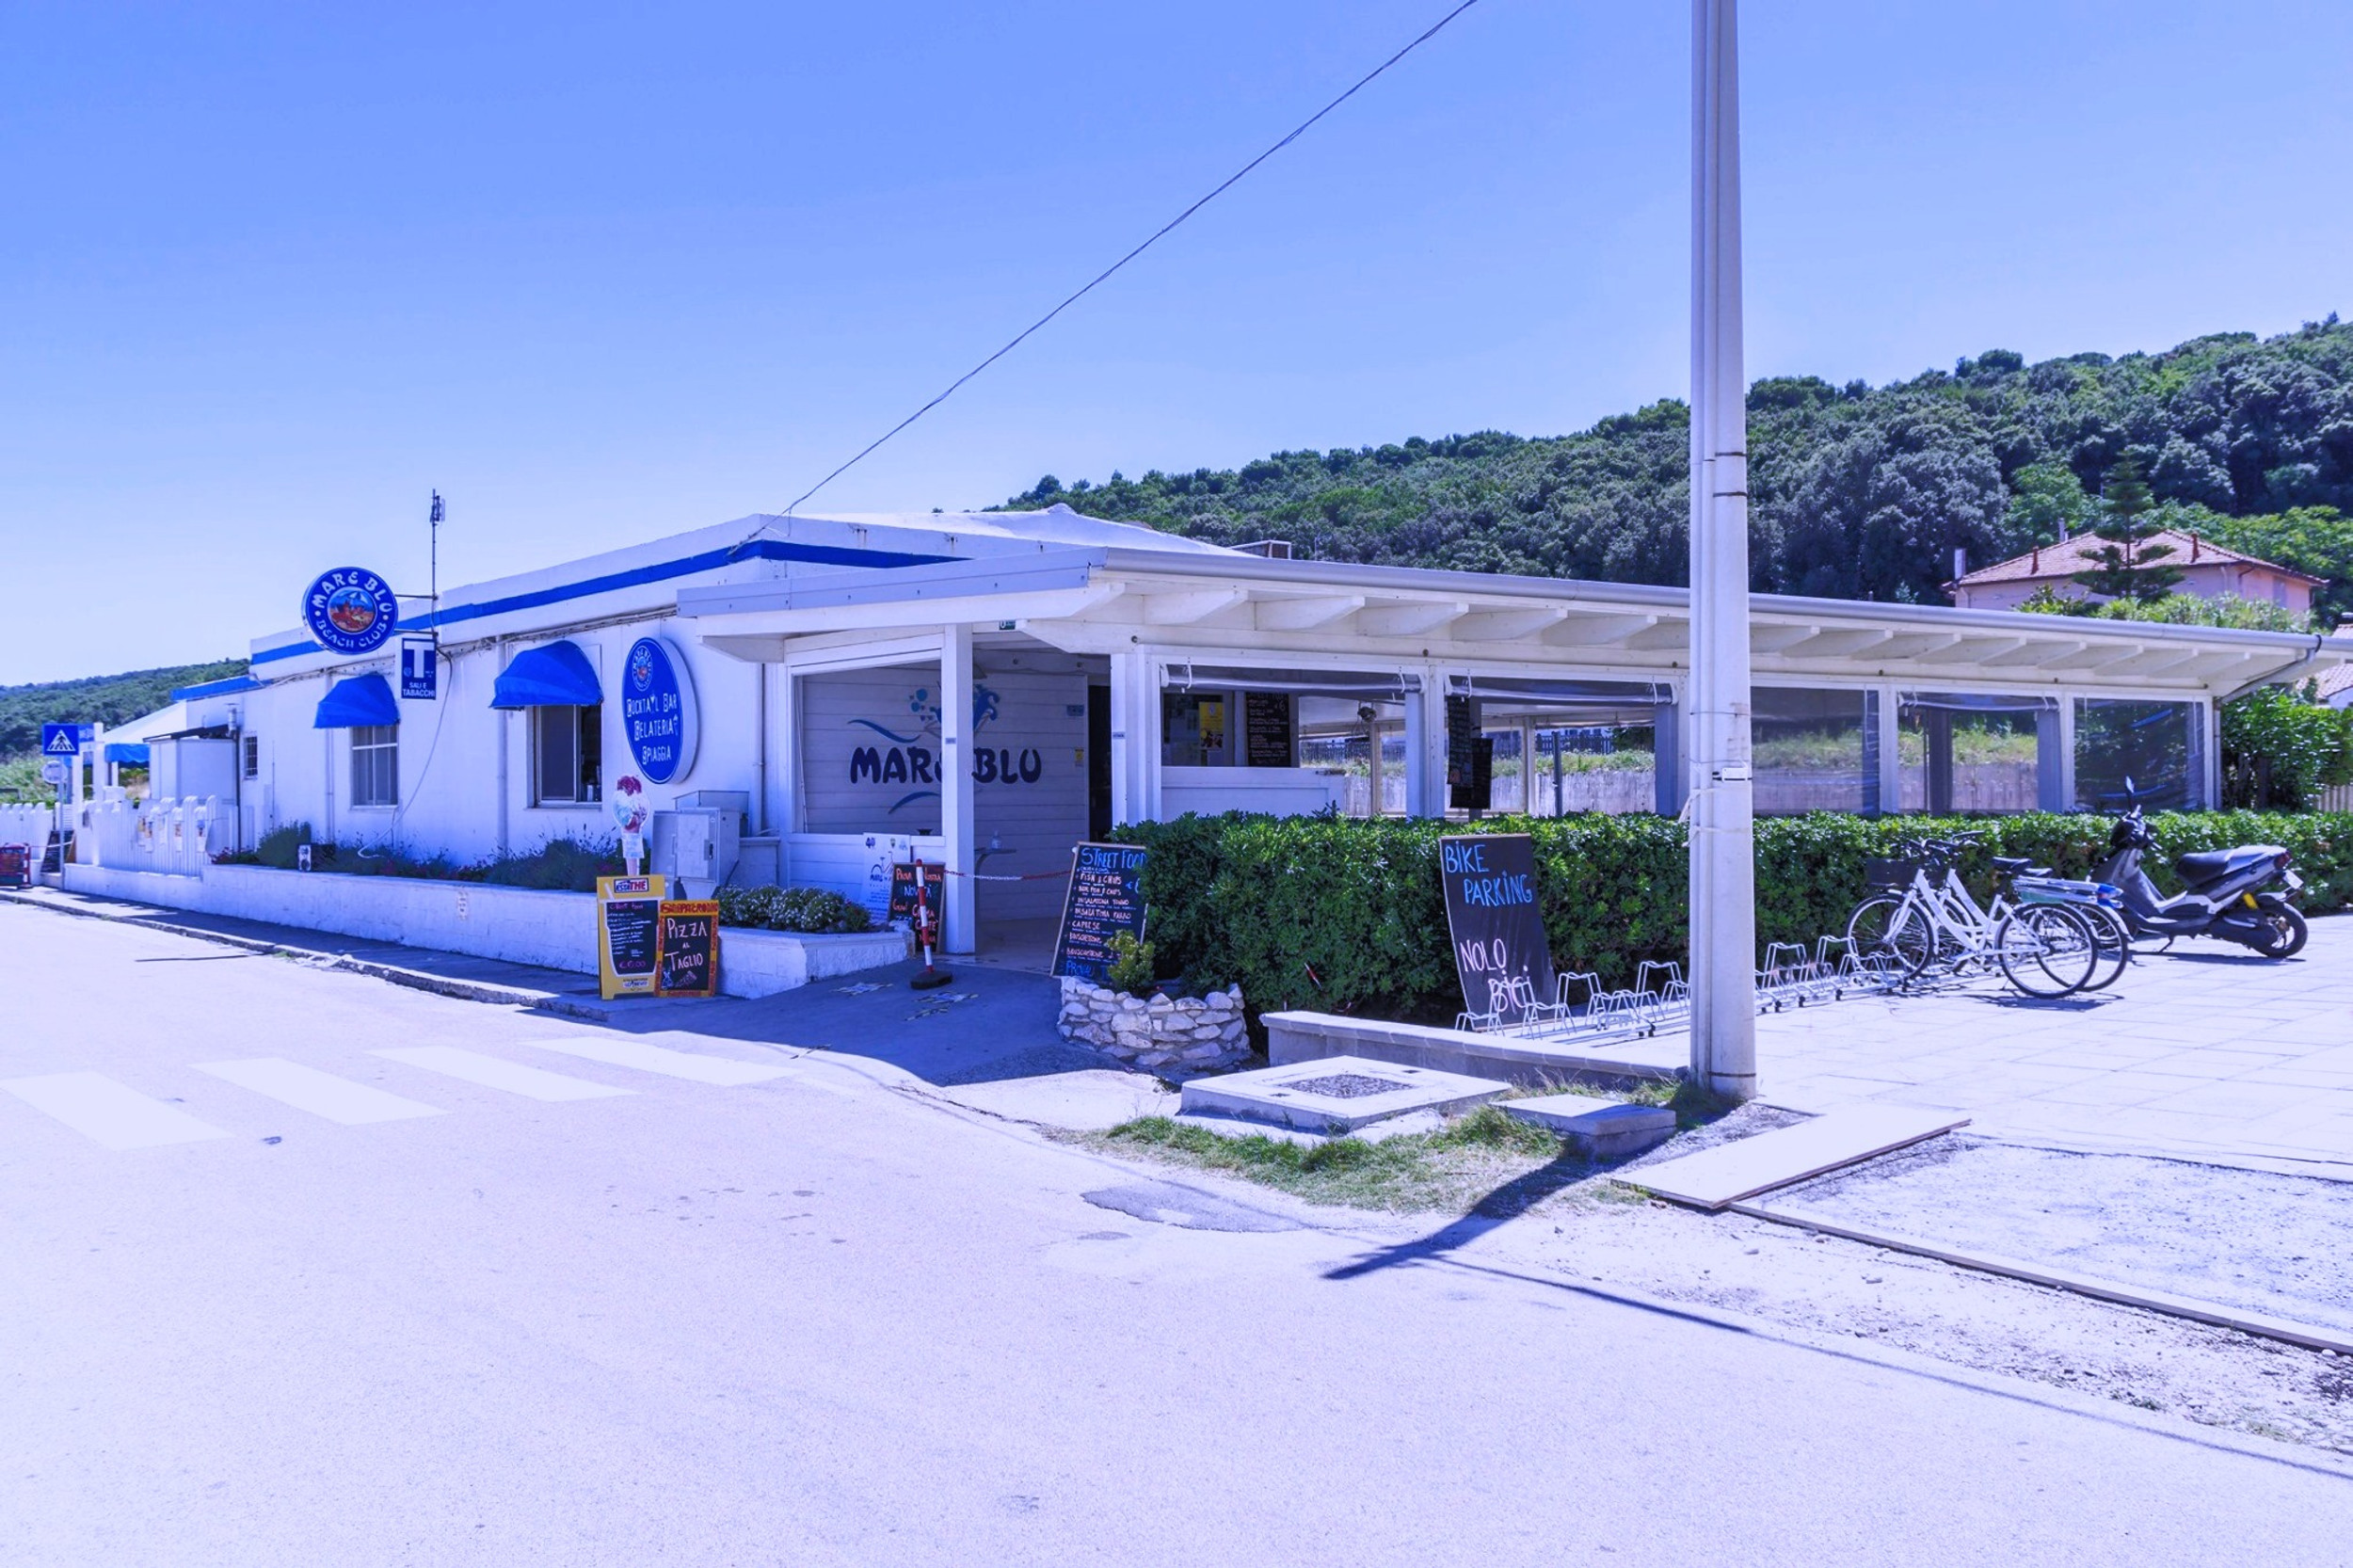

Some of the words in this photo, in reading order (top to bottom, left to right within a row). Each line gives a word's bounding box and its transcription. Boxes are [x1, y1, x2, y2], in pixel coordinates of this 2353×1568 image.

[312, 571, 359, 609] MARE
[315, 620, 354, 648] BEACH
[359, 622, 387, 648] CLUB
[404, 640, 435, 678] T
[403, 689, 435, 697] TABACCHI
[850, 746, 942, 784] MAR
[971, 747, 1042, 784] BLU
[1080, 847, 1119, 869] STREET
[1446, 840, 1489, 873] BIKE
[904, 884, 932, 897] NOVÀ
[1464, 871, 1533, 906] PARKING
[666, 918, 707, 938] PIZZA
[664, 952, 703, 971] TAGLIO
[1460, 938, 1507, 972] NOLO
